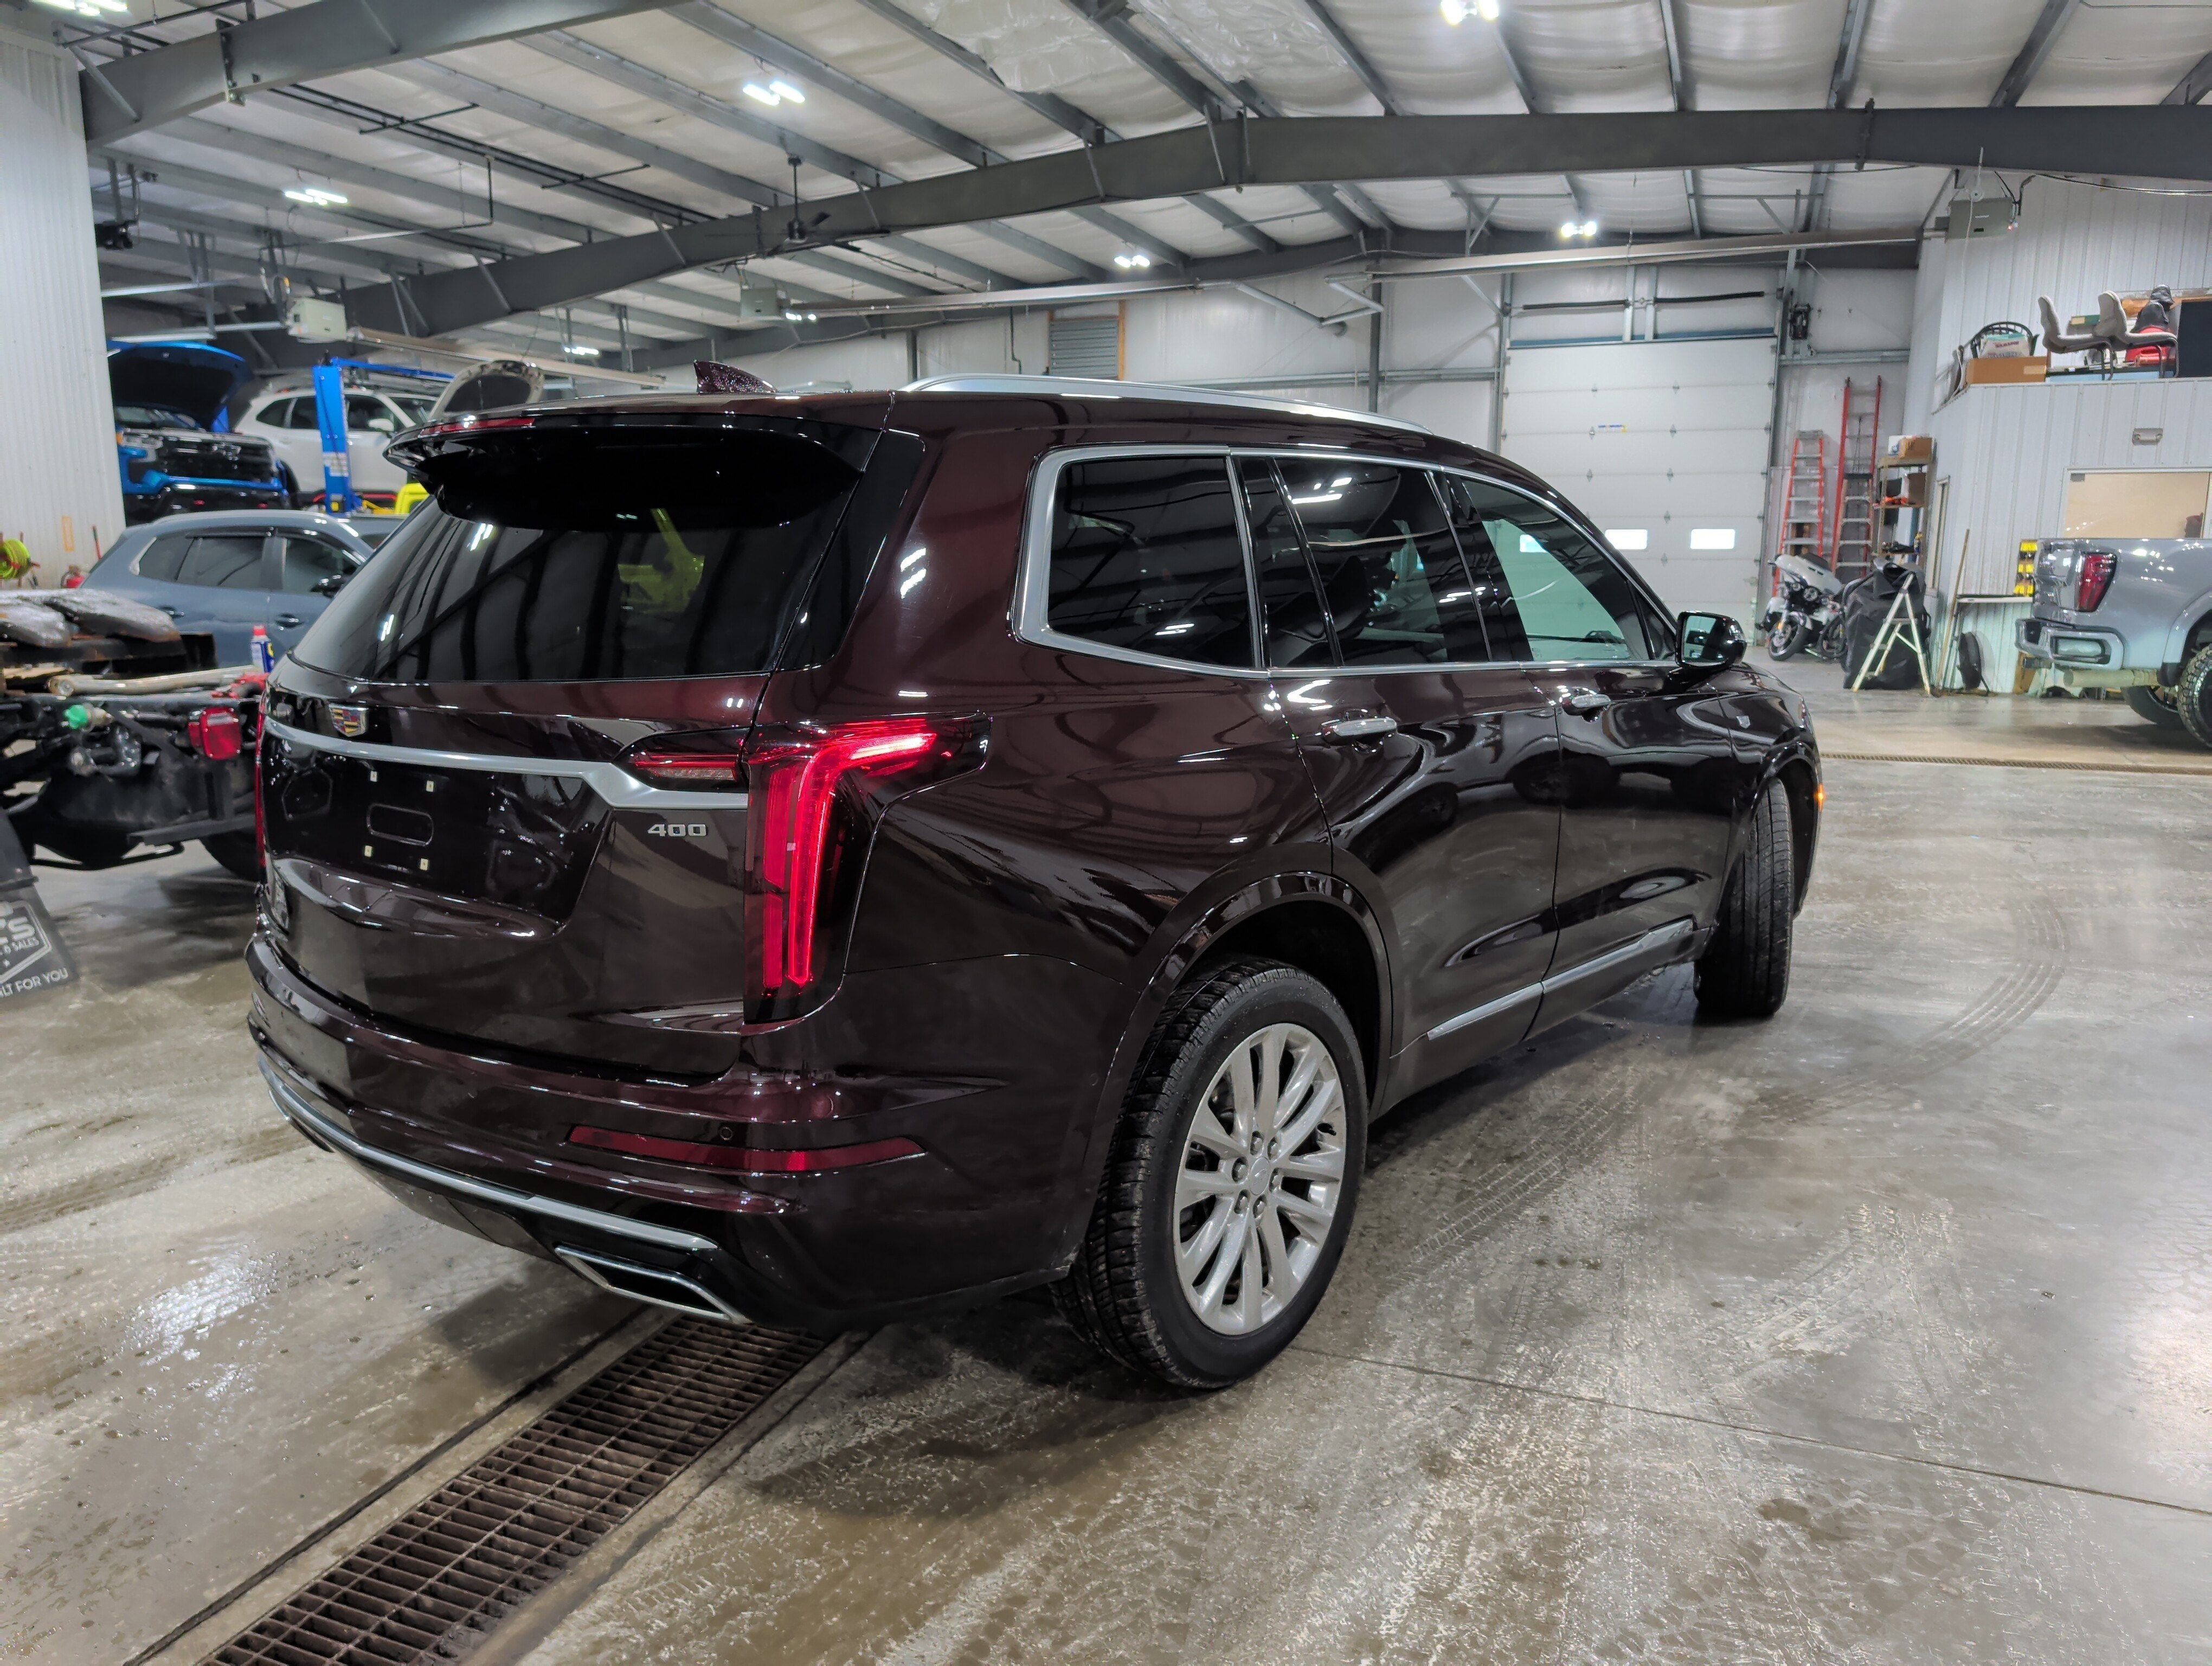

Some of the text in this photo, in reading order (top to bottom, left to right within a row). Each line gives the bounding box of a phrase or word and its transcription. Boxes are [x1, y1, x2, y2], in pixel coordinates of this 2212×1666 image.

[647, 824, 706, 836] 400
[12, 937, 39, 951] SALES
[15, 976, 42, 992] FOR
[41, 967, 68, 983] YOU
